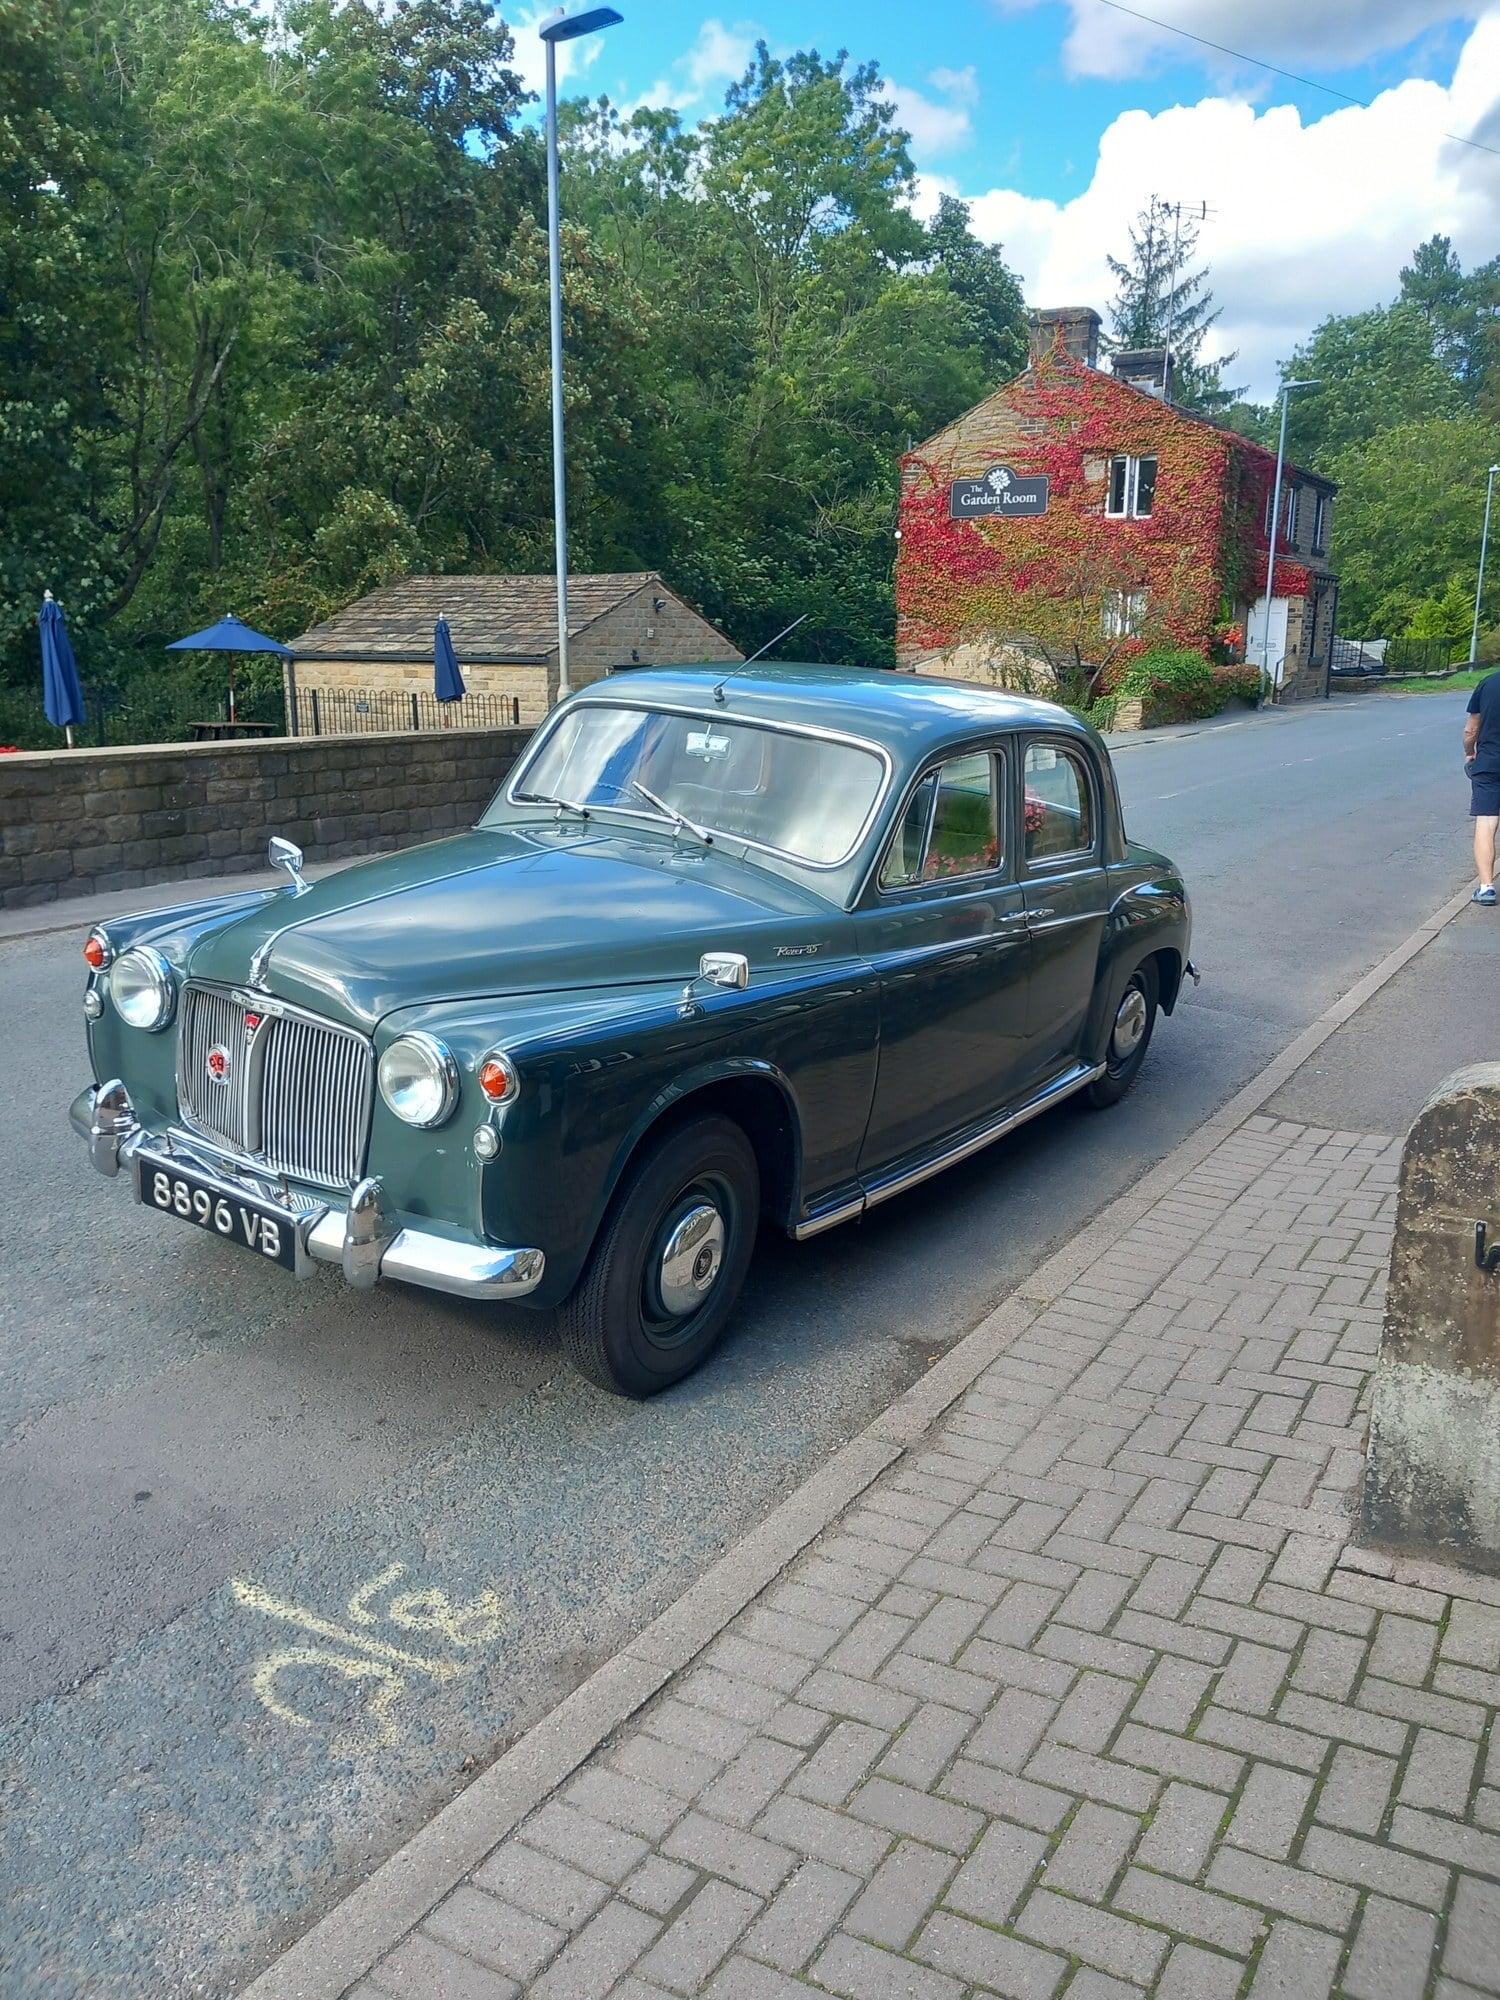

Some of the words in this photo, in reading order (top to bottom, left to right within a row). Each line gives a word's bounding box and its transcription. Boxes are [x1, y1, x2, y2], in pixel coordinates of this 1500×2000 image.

[970, 485, 983, 493] The
[960, 492, 1000, 506] Garden
[1002, 491, 1037, 504] Room
[153, 1172, 233, 1234] 8896
[239, 1207, 281, 1257] VB
